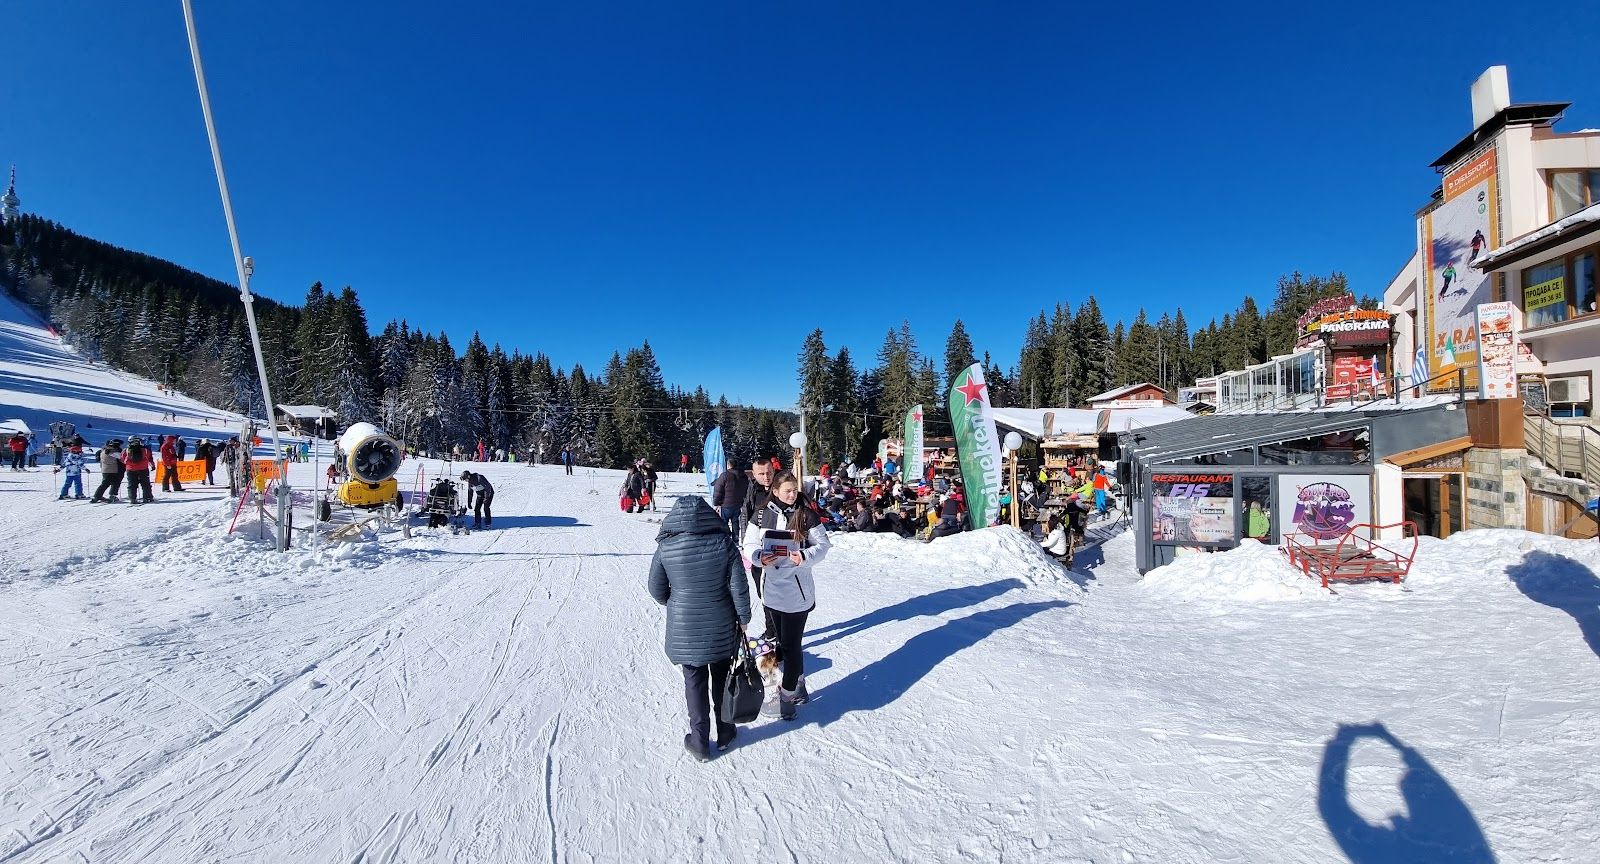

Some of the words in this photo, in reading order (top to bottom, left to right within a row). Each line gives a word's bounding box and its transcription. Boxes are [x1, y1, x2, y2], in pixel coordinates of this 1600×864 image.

[1525, 284, 1551, 299] ПРОДАВА
[1353, 309, 1391, 321] DINNER
[1320, 320, 1390, 332] PANORAMA
[1151, 474, 1233, 483] RESTAURANT
